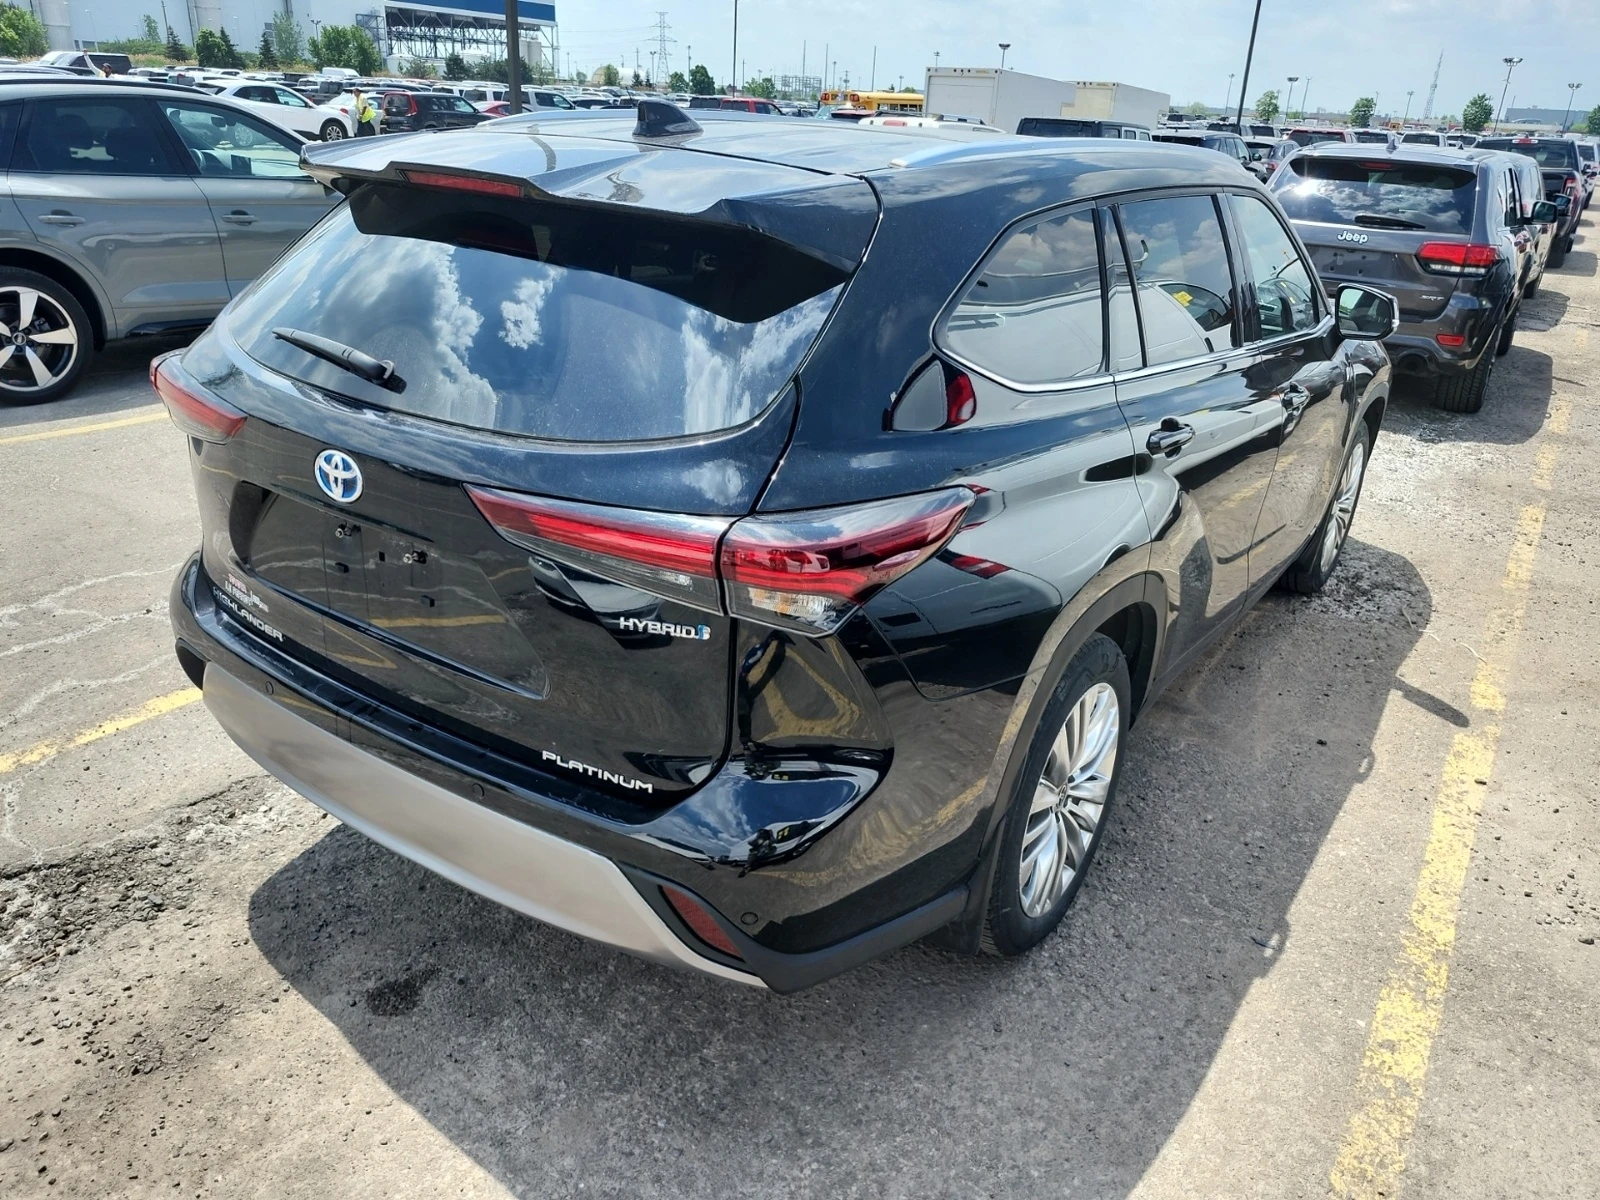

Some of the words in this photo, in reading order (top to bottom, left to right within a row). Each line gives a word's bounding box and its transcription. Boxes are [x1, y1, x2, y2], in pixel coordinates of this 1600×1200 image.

[1338, 231, 1368, 244] Jeep
[213, 586, 283, 642] HIGHLANDER
[620, 616, 696, 639] HYBRID
[542, 750, 653, 794] PLATINUM
